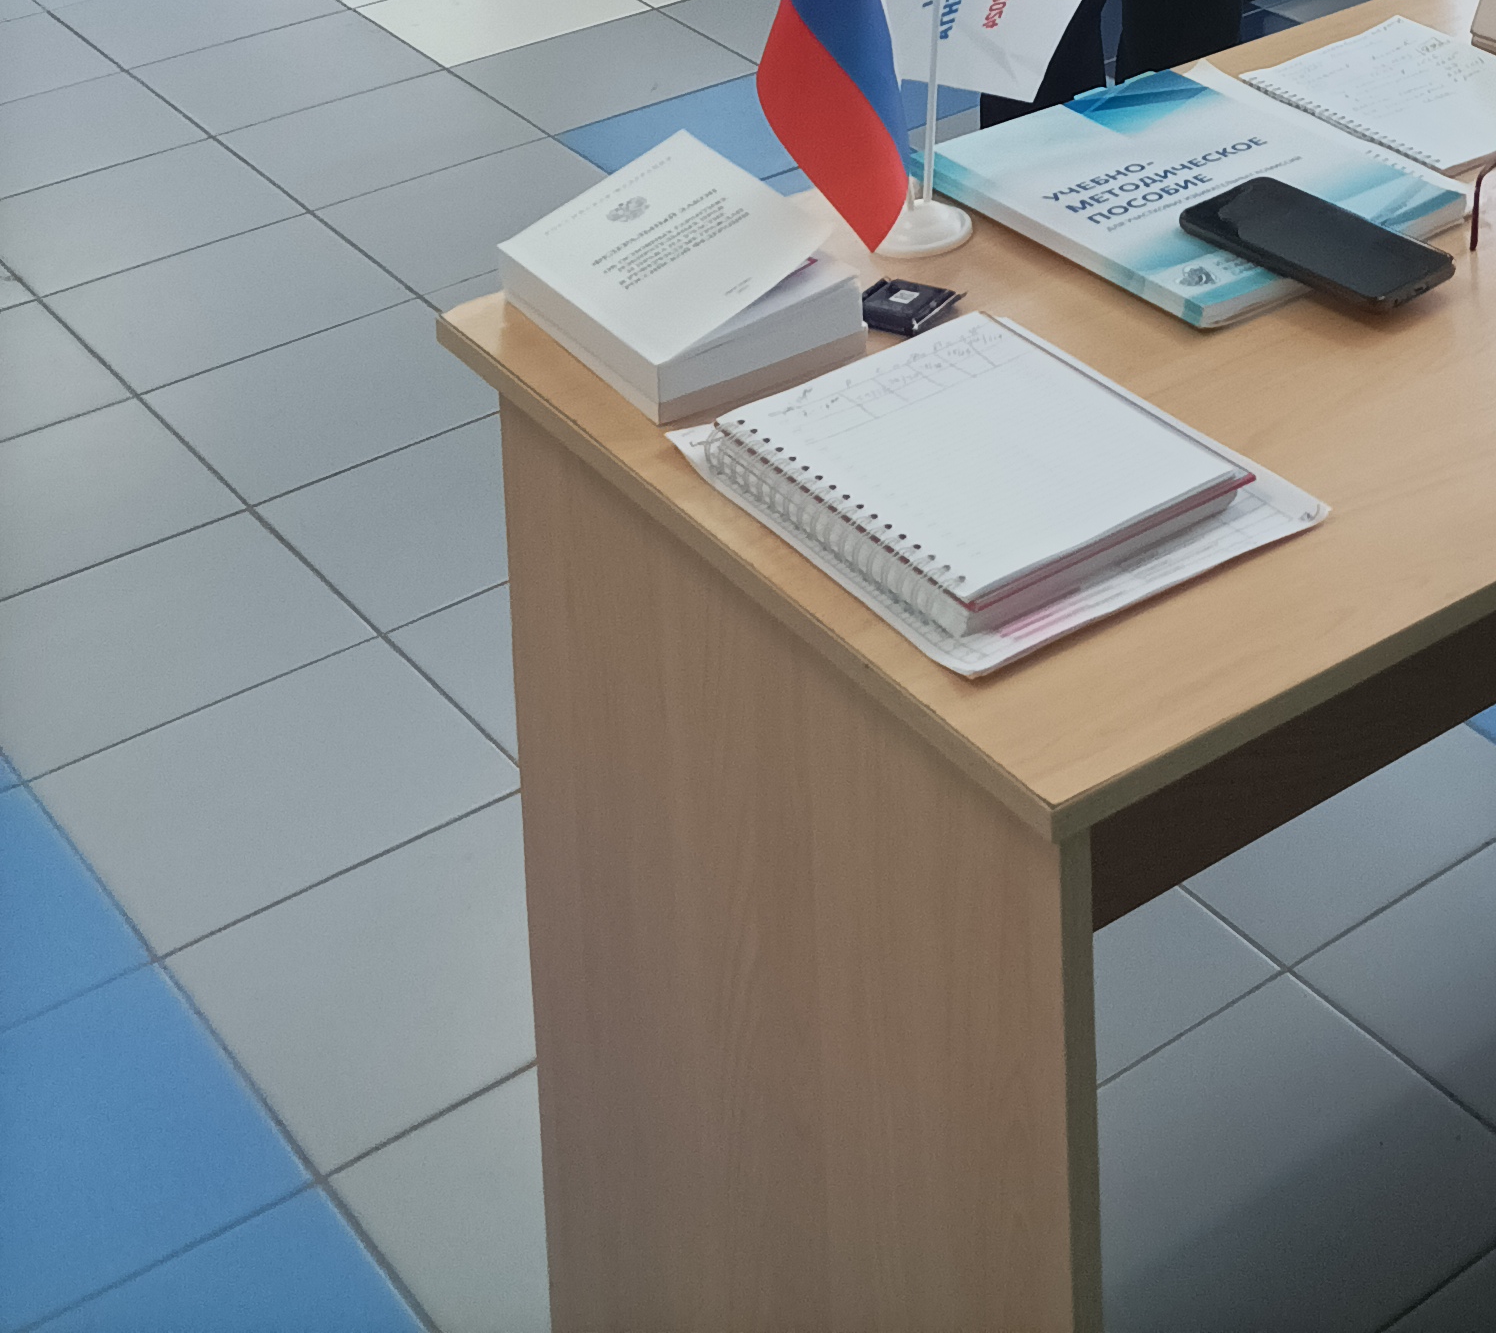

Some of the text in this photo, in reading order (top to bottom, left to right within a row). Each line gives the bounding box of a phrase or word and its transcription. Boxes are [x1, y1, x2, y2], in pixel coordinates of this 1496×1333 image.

[1042, 162, 1155, 202] УЧЕБНО-
[1065, 136, 1268, 213] МЕТОДИЧЕСКОЕ
[1087, 173, 1214, 225] ПОСОБИЕ
